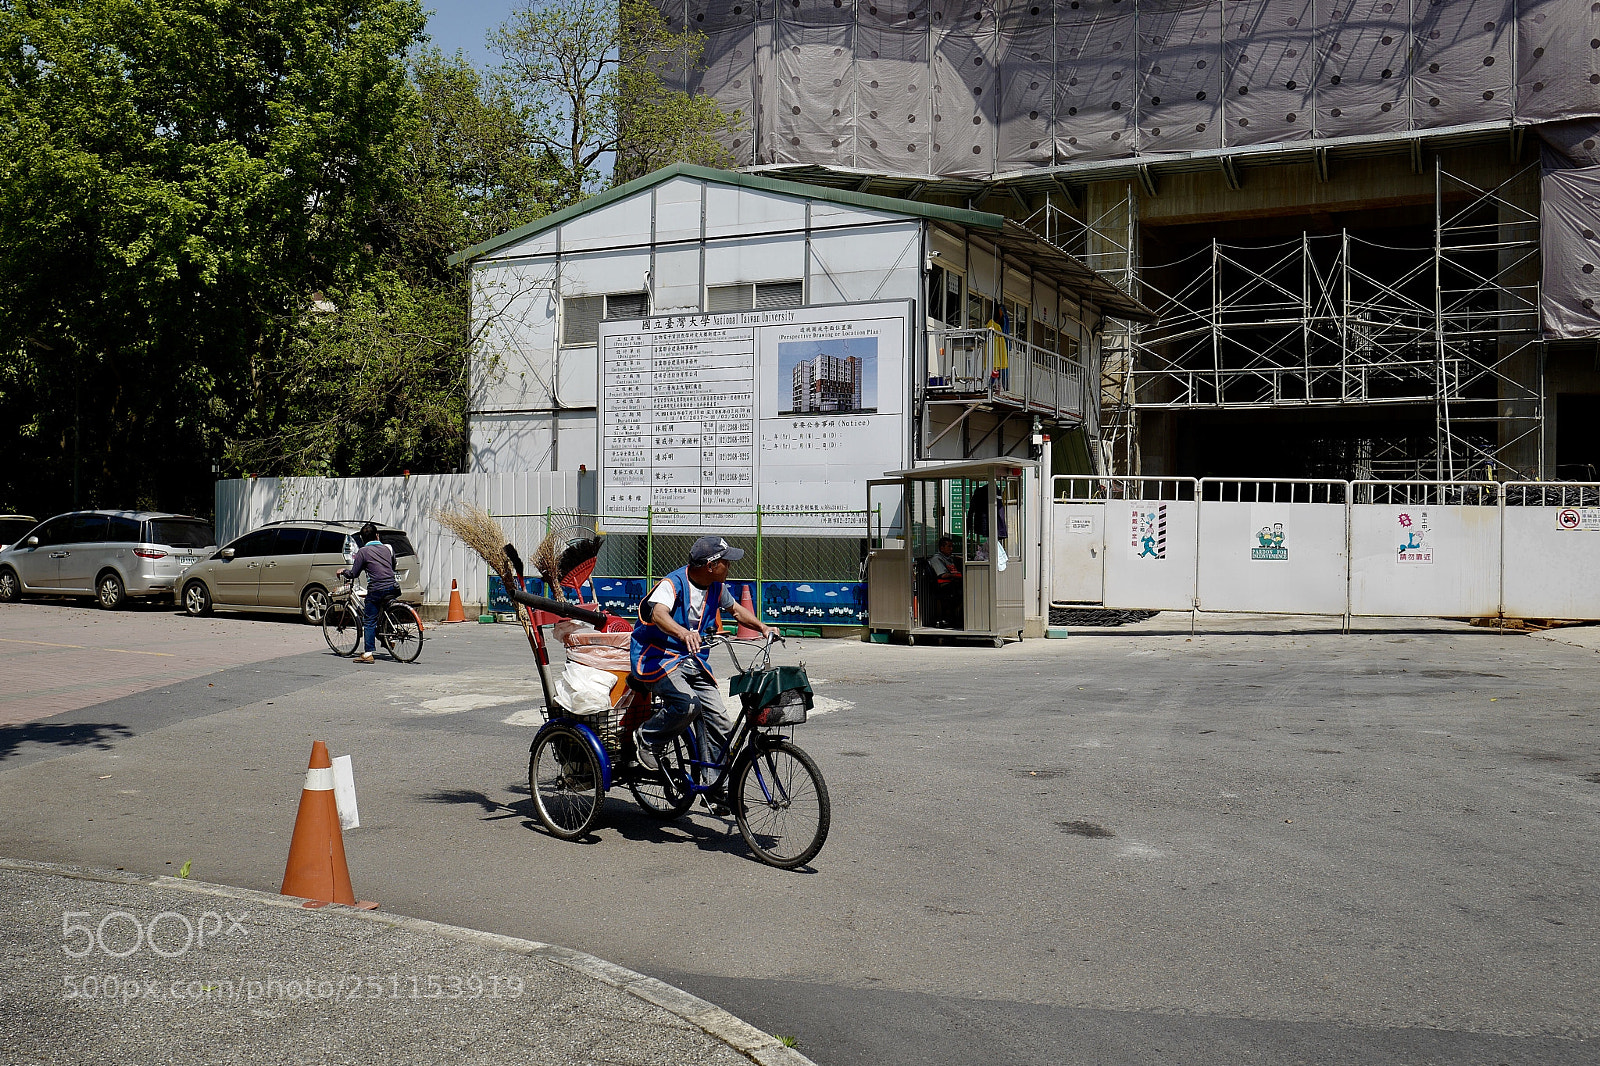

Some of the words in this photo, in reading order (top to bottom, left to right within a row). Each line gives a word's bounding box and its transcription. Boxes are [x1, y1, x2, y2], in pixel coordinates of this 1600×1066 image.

[642, 315, 710, 330] 國立臺灣大學
[713, 313, 738, 326] National
[741, 311, 759, 324] Taiwan
[762, 310, 795, 323] University
